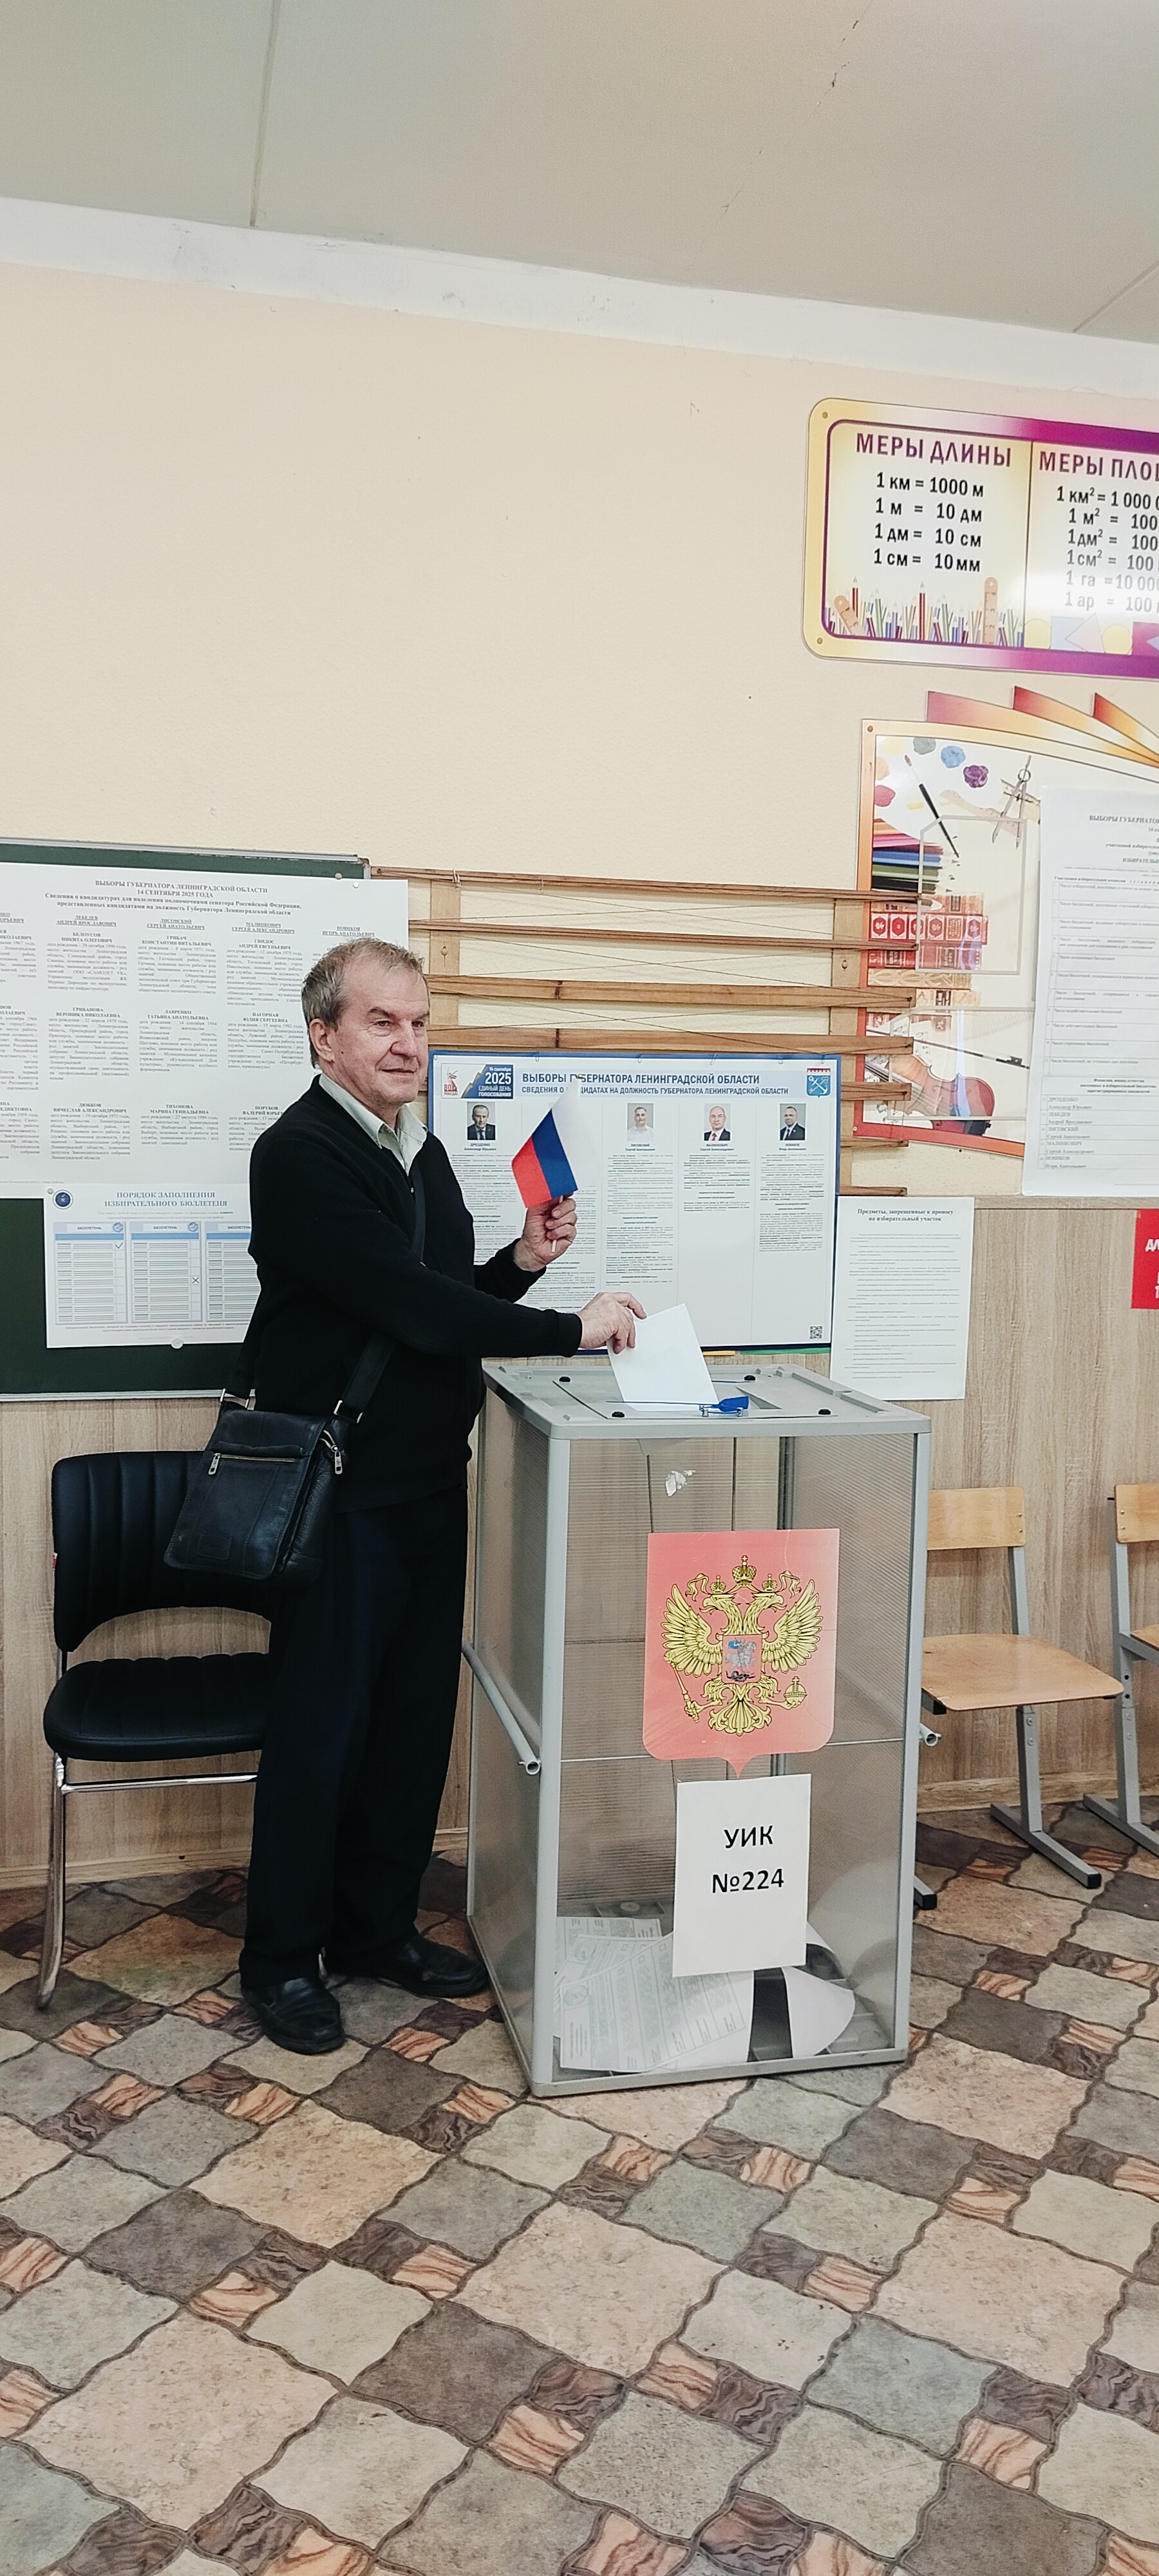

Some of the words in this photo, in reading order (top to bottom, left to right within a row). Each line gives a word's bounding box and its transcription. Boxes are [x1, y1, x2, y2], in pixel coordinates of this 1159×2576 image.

[856, 433, 923, 458] МЕРЫ
[930, 441, 1011, 466] ДЛИНЫ
[1039, 451, 1103, 475] МЕРЫ
[1111, 459, 1159, 481] ПЛО
[876, 471, 885, 488] 1
[889, 477, 910, 490] км
[930, 477, 968, 495] 1000
[972, 484, 983, 497] м
[1057, 486, 1064, 502] 1
[1111, 491, 1118, 507] 1
[1124, 493, 1151, 509] 000
[875, 497, 883, 513] 1
[890, 502, 901, 515] м
[936, 502, 955, 519] 10
[959, 509, 982, 523] дм
[1069, 508, 1076, 524] 1
[1131, 514, 1158, 531] 100
[874, 522, 883, 538] 1
[887, 528, 909, 542] дм
[935, 528, 954, 544] 10
[960, 534, 981, 547] см
[1132, 535, 1158, 551] 100
[874, 548, 882, 564] 1
[887, 553, 908, 566] см
[934, 553, 953, 569] 10
[956, 558, 980, 571] мм
[1127, 554, 1154, 571] 100
[1066, 570, 1073, 585] 1
[1081, 574, 1095, 587] га
[1116, 574, 1133, 589] 10
[1065, 591, 1072, 606] 1
[1077, 596, 1094, 611] ар
[1126, 596, 1152, 612] 100
[485, 1072, 511, 1084] 2025
[522, 1073, 567, 1082] ВЫБОРЫ
[569, 1074, 633, 1083] ГБЕРНАТОРА
[634, 1073, 715, 1084] ЛЕНИНГРАДСКОЙ
[717, 1075, 760, 1084] ОБЛАСТИ
[704, 1086, 760, 1095] ЛЕНИНГРАДСКОЙ
[723, 1825, 773, 1848] УИК
[712, 1868, 784, 1893] №224
